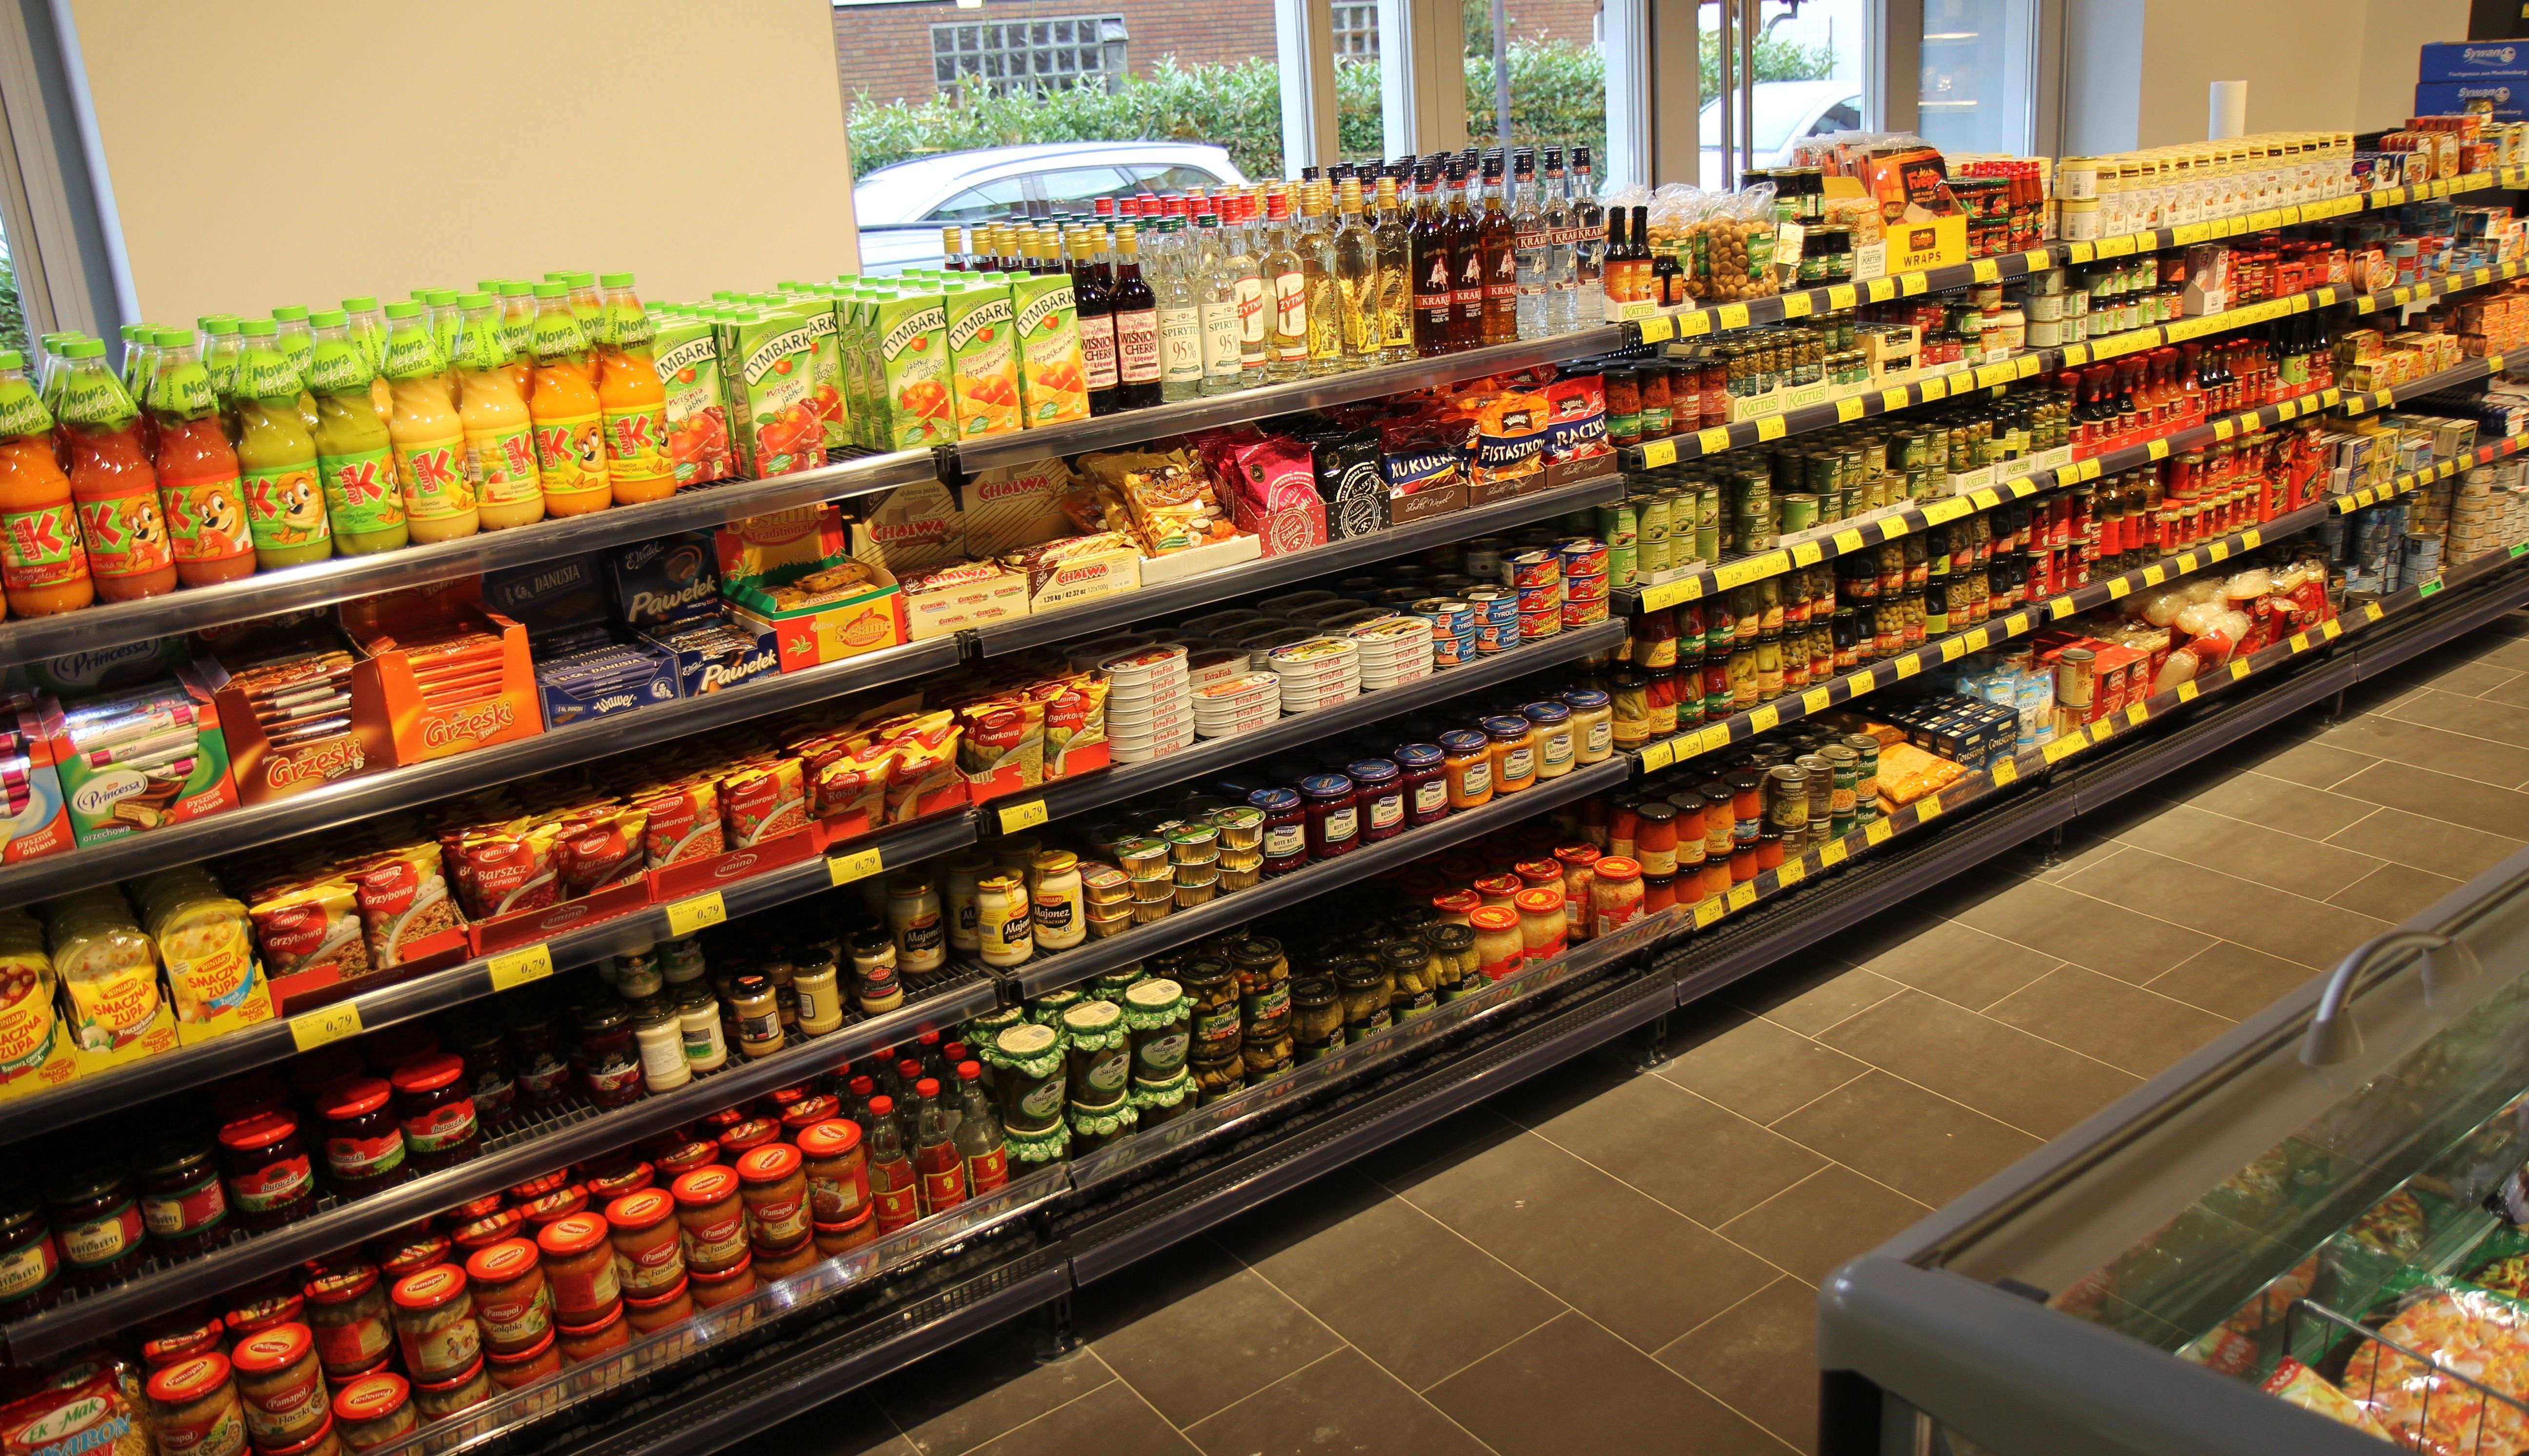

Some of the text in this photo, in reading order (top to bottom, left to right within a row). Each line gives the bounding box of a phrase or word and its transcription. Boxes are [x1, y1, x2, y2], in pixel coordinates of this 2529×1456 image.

[2464, 48, 2500, 59] Sywan
[2458, 87, 2495, 98] Sywan
[1908, 173, 1940, 190] Fuego
[1862, 255, 1881, 264] KATTUS
[1904, 252, 1941, 267] WRAPS
[1985, 267, 1995, 276] 2,59
[1881, 286, 1891, 294] 1,99
[1913, 279, 1924, 288] 3,49
[1030, 287, 1045, 298] 1936
[1843, 293, 1854, 301] 3,69
[966, 299, 981, 310] 1936
[1279, 291, 1305, 311] ŻYTNIA
[1798, 301, 1809, 310] 2,99
[899, 307, 913, 319] 1936
[1018, 291, 1076, 330] TYMBARK
[1624, 304, 1654, 317] KATTUS
[1733, 312, 1746, 321] 2,59
[950, 302, 1012, 343] TYMBARK
[1657, 324, 1670, 335] 1,99
[1695, 319, 1707, 330] 1,39
[538, 326, 574, 345] Nowa
[762, 329, 777, 341] 1936
[883, 311, 946, 355] TYMBARK
[1162, 325, 1199, 338] SPIRYTUS
[390, 339, 423, 359] Nowa
[542, 336, 580, 353] lekka
[663, 339, 680, 350] 1936
[1026, 328, 1072, 355] pomarańcza
[1125, 343, 1157, 355] CHERRY
[393, 347, 429, 366] lekka
[539, 345, 581, 362] butelka
[745, 332, 811, 378] TYMBARK
[958, 340, 1007, 368] pomarańcza
[1034, 335, 1076, 365] brzoskwinia
[1173, 341, 1197, 359] 95%
[391, 359, 431, 376] butelka
[902, 358, 929, 378] jabłko
[965, 348, 1011, 379] brzoskwinia
[669, 387, 703, 406] wiśnia
[766, 379, 800, 399] wiśnia
[780, 385, 805, 413] jabłko
[1787, 389, 1825, 409] KATTUS
[682, 394, 708, 421] jabłko
[1739, 398, 1777, 418] KATTUS
[1849, 405, 1861, 414] 1,99
[1771, 424, 1783, 434] 1,79
[613, 421, 634, 456] KUBUŚ
[1714, 435, 1727, 444] 2,79
[1661, 451, 1674, 460] 4,19
[413, 458, 434, 493] KUBUŚ
[2007, 462, 2030, 476] KATTUS
[1964, 473, 1989, 489] KATTUS
[750, 524, 811, 541] Traditional
[10, 522, 36, 561] KUBUŚ
[1807, 549, 1819, 558] 1,29
[1752, 565, 1764, 575] 1,19
[1775, 558, 1786, 568] 1,19
[535, 565, 580, 591] DANUSIA
[1730, 572, 1742, 581] 1,29
[1687, 584, 1699, 594] 1,29
[629, 575, 717, 622] Pawełek
[1659, 593, 1671, 603] 1,29
[836, 618, 891, 642] Sesame
[848, 633, 883, 645] Traditional
[1395, 636, 1418, 647] EvraFish
[592, 659, 640, 673] DANUSIA
[702, 649, 777, 691] Pawełek
[1151, 664, 1174, 678] EvraFish
[1314, 658, 1341, 670] EvraFish
[1205, 669, 1232, 681] EvraFish
[1235, 693, 1262, 705] EvraFish
[1815, 695, 1827, 705] 2,09
[424, 700, 514, 748] Grześki
[1764, 713, 1777, 724] 2,29
[480, 724, 501, 738] TOFFI
[980, 728, 1020, 743] Ogórkowa
[1715, 732, 1727, 742] 2,19
[1155, 741, 1180, 757] EvraFish
[1686, 741, 1699, 752] 2,29
[1657, 750, 1671, 760] 1,89
[268, 738, 365, 788] Grześki
[354, 757, 365, 769] 6
[87, 780, 142, 808] Princessa
[186, 789, 221, 810] pysznie
[731, 791, 777, 811] Pomidorowa
[1380, 797, 1397, 806] Provitus
[193, 797, 224, 815] oblana
[653, 799, 680, 812] amino
[1024, 805, 1043, 819] 0,79
[83, 826, 131, 842] orzechowa
[1275, 827, 1296, 837] Provitus
[583, 835, 607, 850] amino
[1832, 846, 1844, 856] 3,79
[855, 856, 876, 871] 0,79
[478, 864, 527, 881] Barszcz
[1789, 867, 1801, 877] 2,59
[485, 875, 522, 888] czerwony
[365, 885, 413, 905] Grzybowa
[1742, 890, 1752, 900] 2,79
[547, 910, 582, 923] amino
[698, 904, 719, 920] 0,79
[1035, 906, 1070, 918] Majonez
[1709, 905, 1720, 915] 2,59
[270, 927, 322, 948] Grzybowa
[201, 954, 231, 971] WINIARY
[521, 957, 545, 975] 0,79
[188, 956, 242, 989] SMACZNA
[207, 976, 240, 999] ZUPA
[94, 982, 150, 1017] SMACZNA
[114, 1003, 145, 1026] ZUPA
[119, 1010, 157, 1037] Pieczarkowa
[326, 1014, 352, 1032] 0,79
[432, 1113, 466, 1134] Buraczki
[262, 1172, 299, 1192] Buraczki
[762, 1203, 794, 1216] Pamapol
[771, 1219, 790, 1230] Bigos
[645, 1244, 675, 1262] Pamapol
[651, 1261, 678, 1278] Fasolka
[408, 1273, 446, 1293] Pamapol
[487, 1305, 520, 1317] Pamapol
[490, 1322, 522, 1334] Gołąbki
[168, 1361, 205, 1385] Pamapol
[270, 1387, 307, 1406] Pamapol
[278, 1405, 310, 1426] Flaczki
